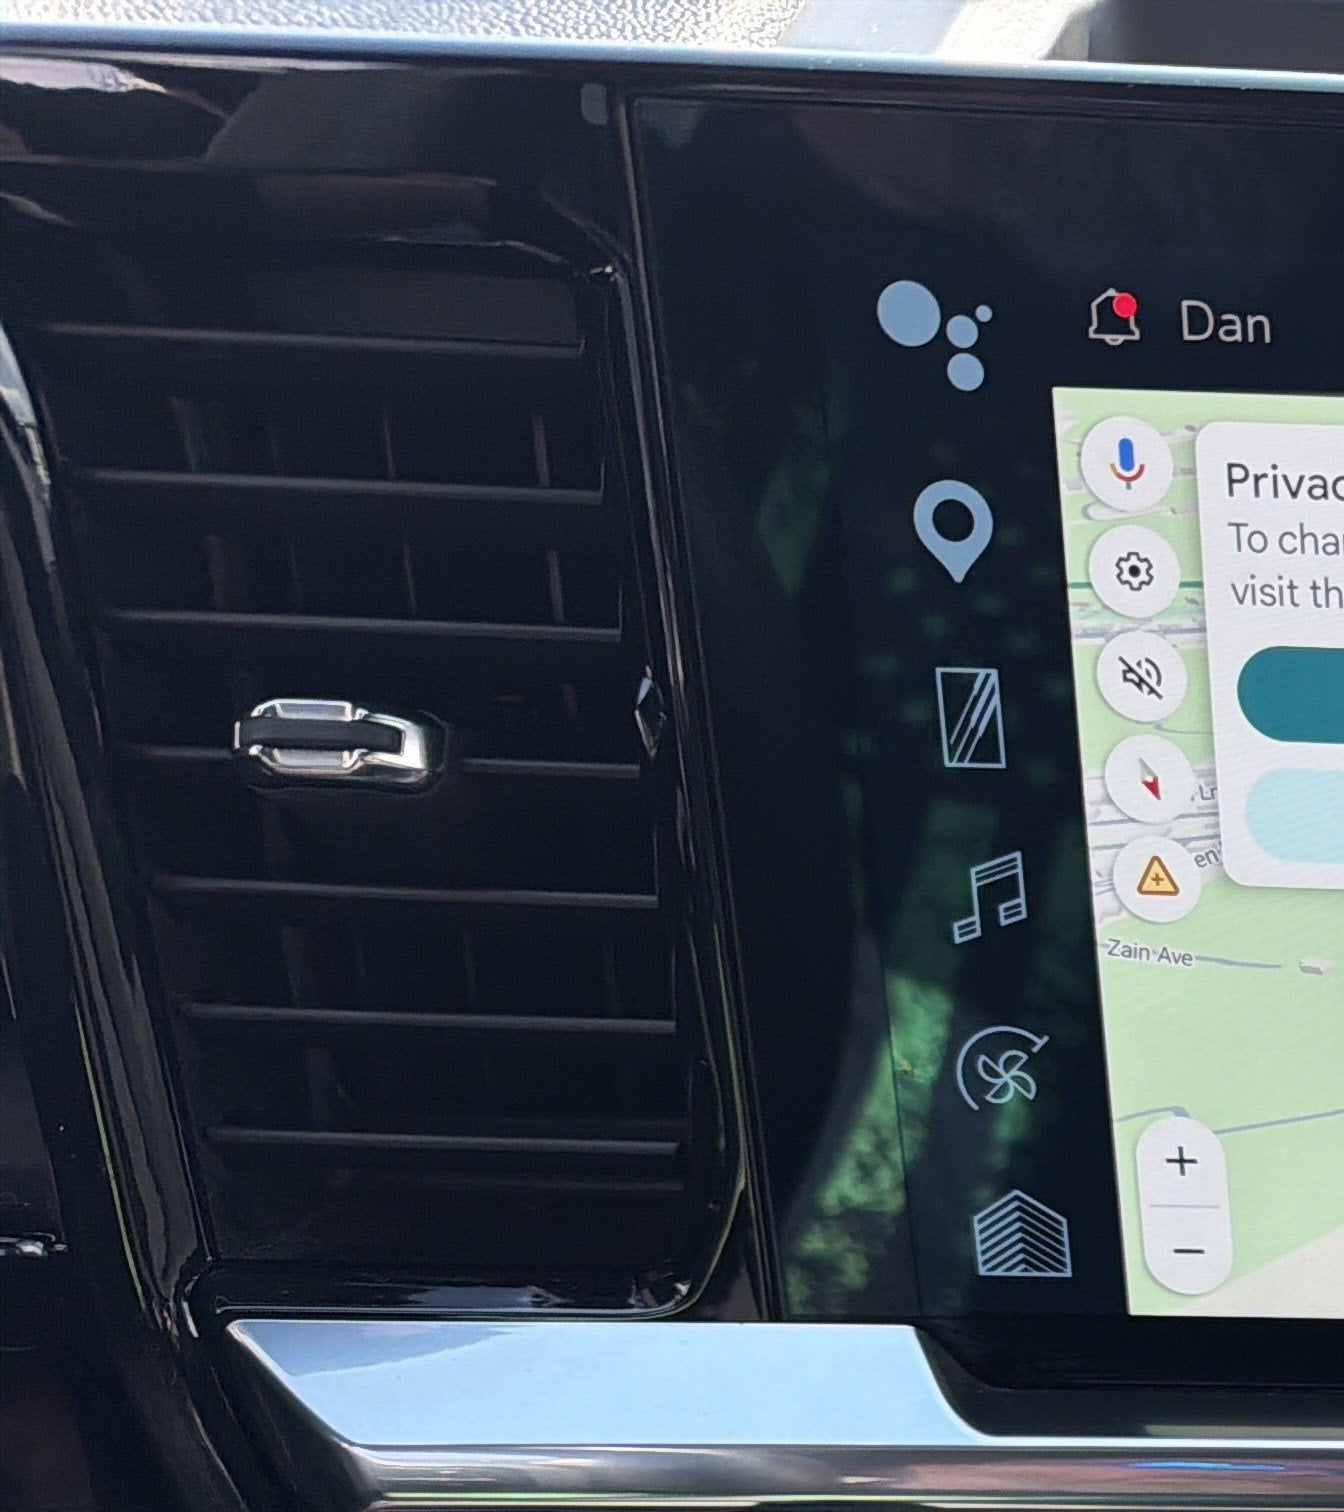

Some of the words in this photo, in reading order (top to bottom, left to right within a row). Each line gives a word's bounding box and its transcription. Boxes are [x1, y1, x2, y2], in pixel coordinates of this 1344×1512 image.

[1181, 300, 1271, 343] Dan
[1227, 522, 1268, 554] To
[1231, 574, 1298, 607] visit
[1108, 938, 1150, 961] Zain
[1156, 946, 1194, 967] Ave
